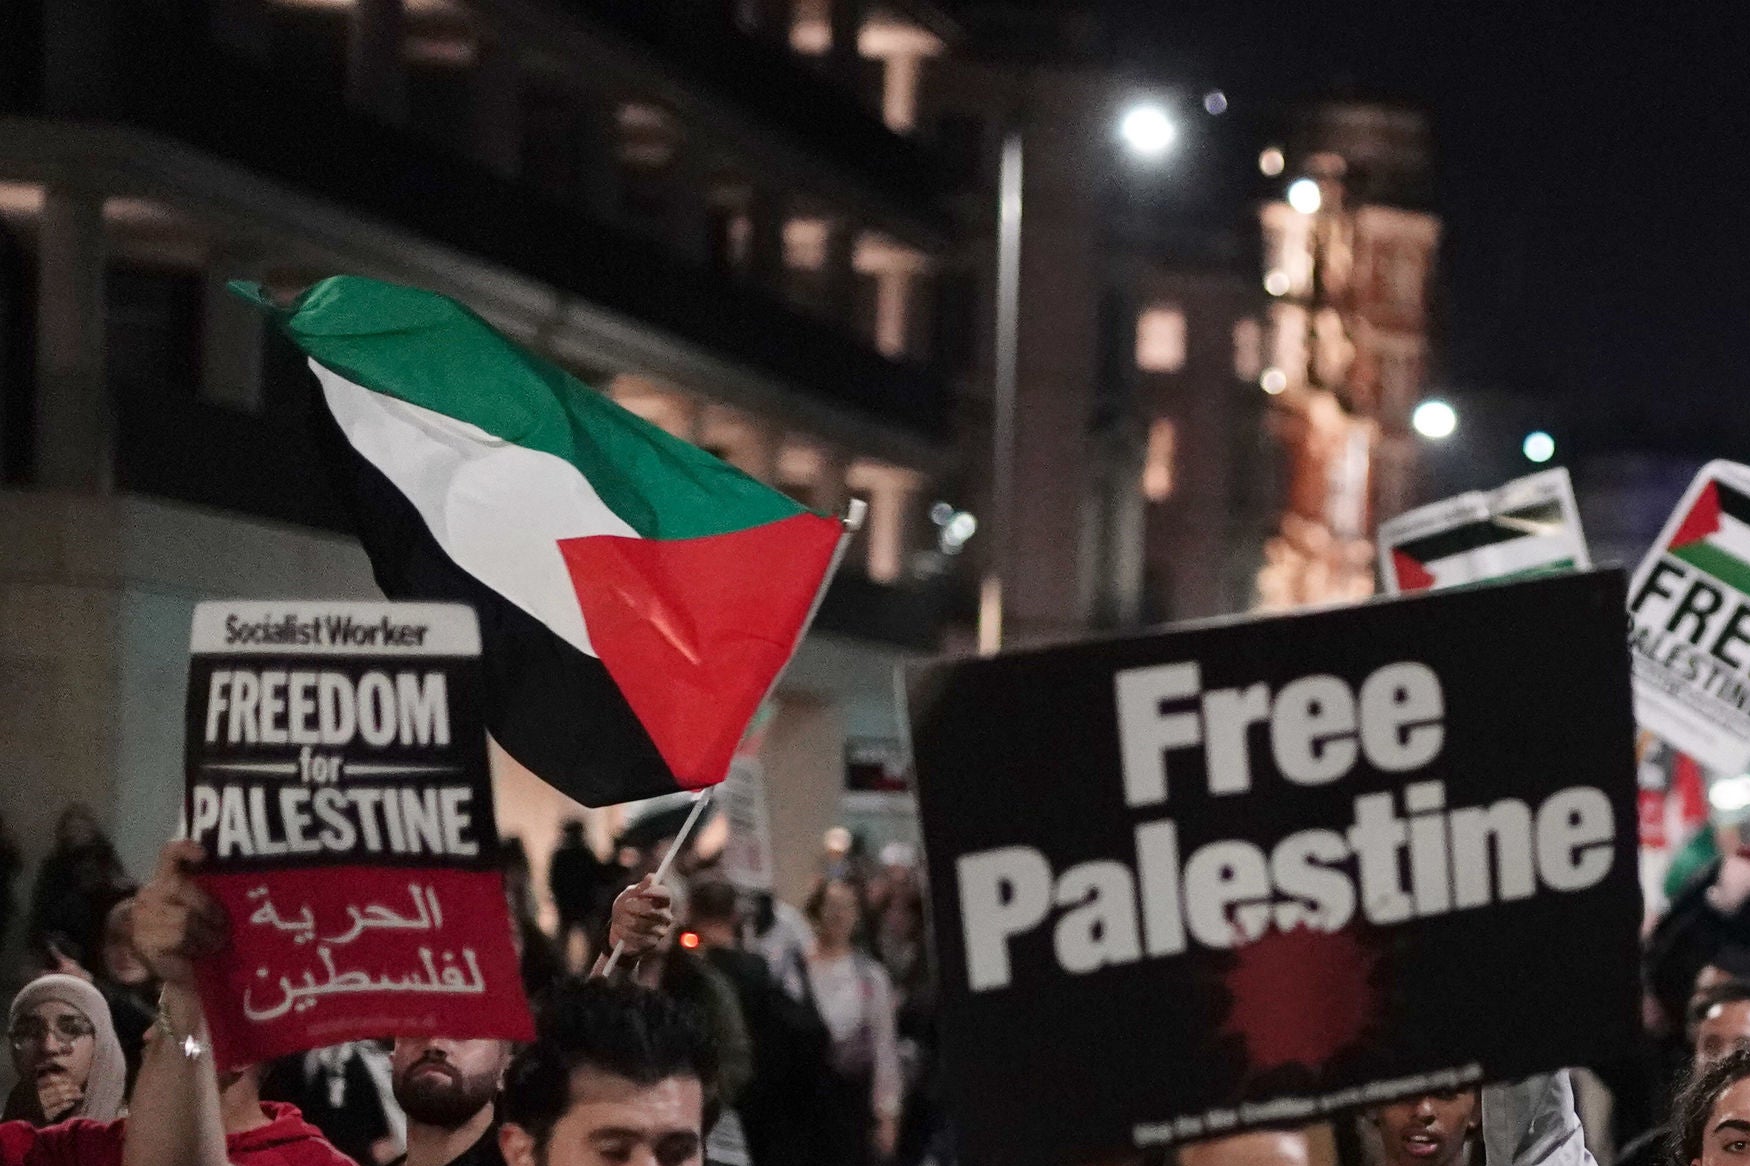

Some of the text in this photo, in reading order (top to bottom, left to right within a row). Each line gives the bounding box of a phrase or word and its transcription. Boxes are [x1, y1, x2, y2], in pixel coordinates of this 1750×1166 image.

[225, 613, 429, 647] Socialist Worker
[204, 670, 451, 746] FREEDOM
[1114, 660, 1446, 807] Free
[299, 745, 343, 783] for
[191, 785, 480, 858] PALESTINE
[246, 882, 443, 944] الحرية
[955, 780, 1616, 993] Palestine
[243, 945, 485, 1024] لفلسطين
